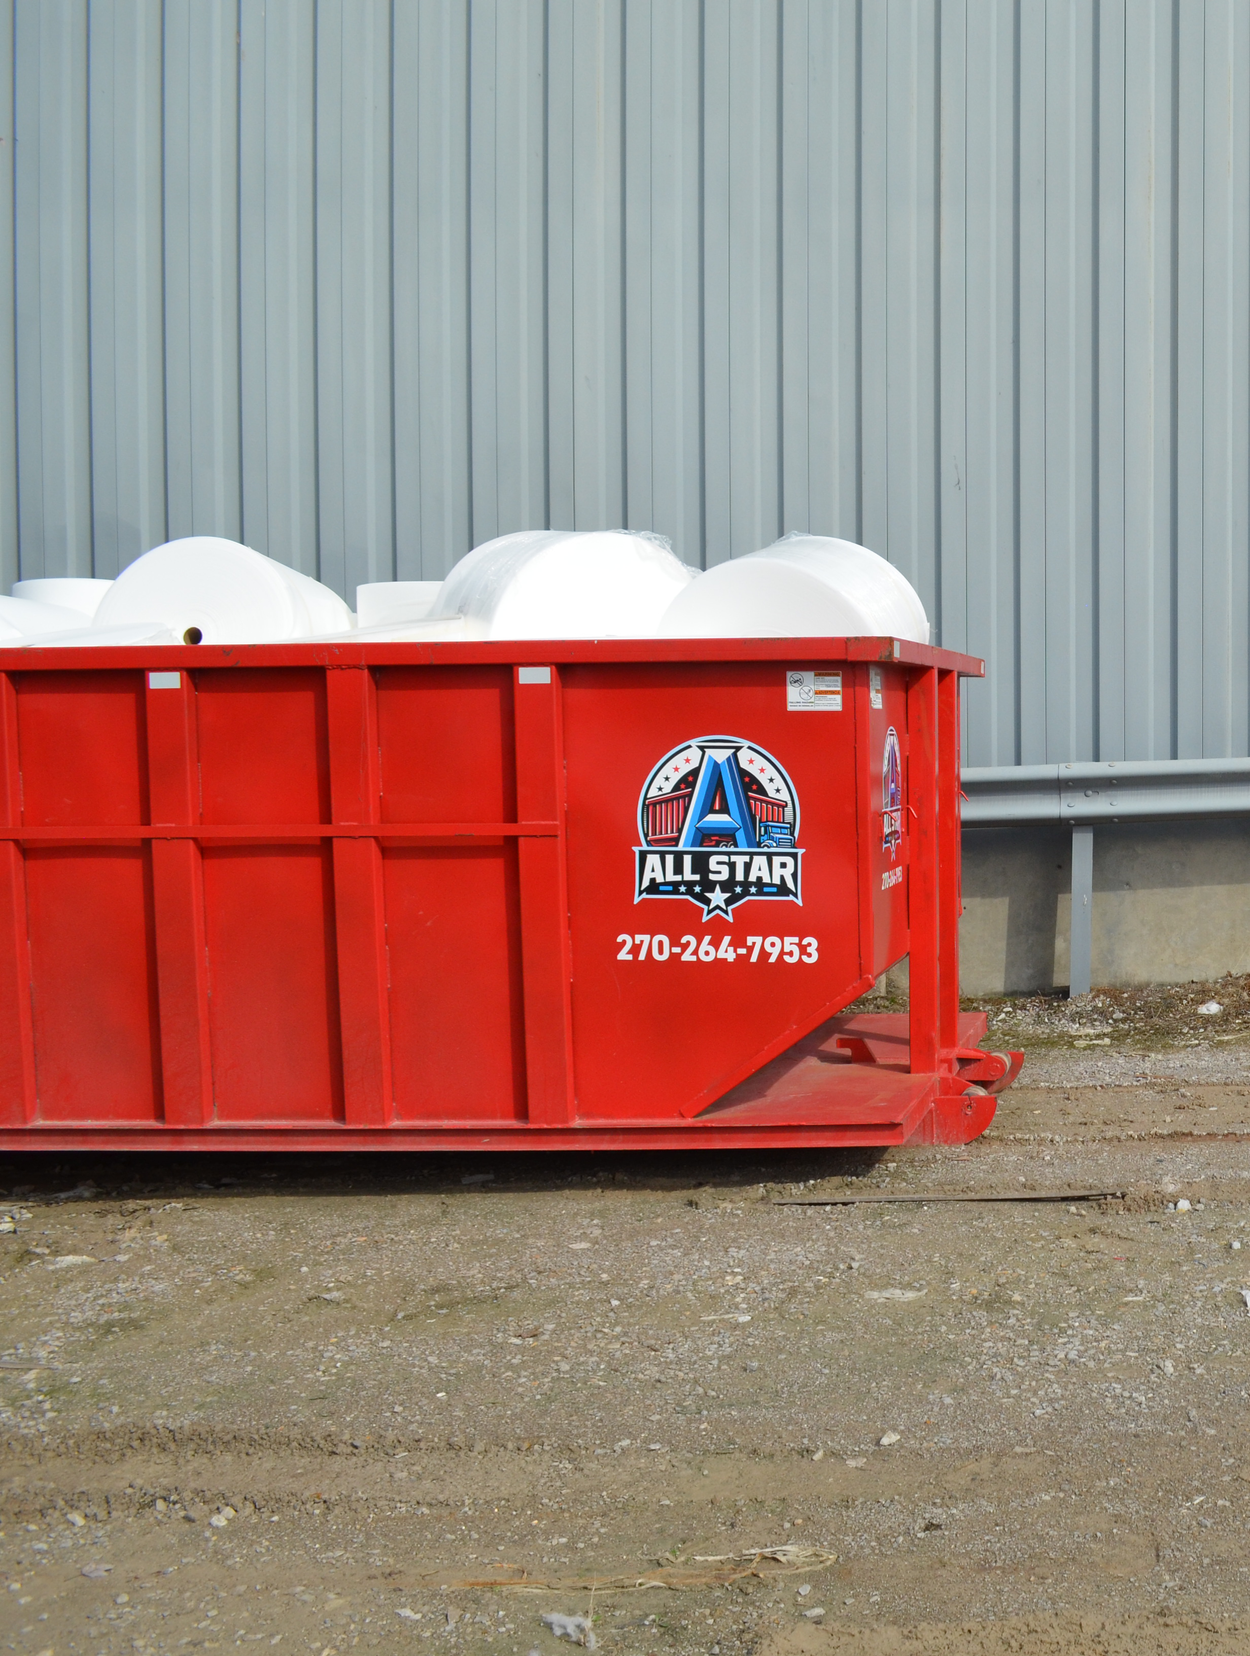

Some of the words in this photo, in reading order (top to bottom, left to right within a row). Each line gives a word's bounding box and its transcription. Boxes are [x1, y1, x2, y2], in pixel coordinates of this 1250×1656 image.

[641, 854, 701, 891] ALL
[708, 854, 796, 893] STAR
[616, 933, 819, 964] 270-264-7953
